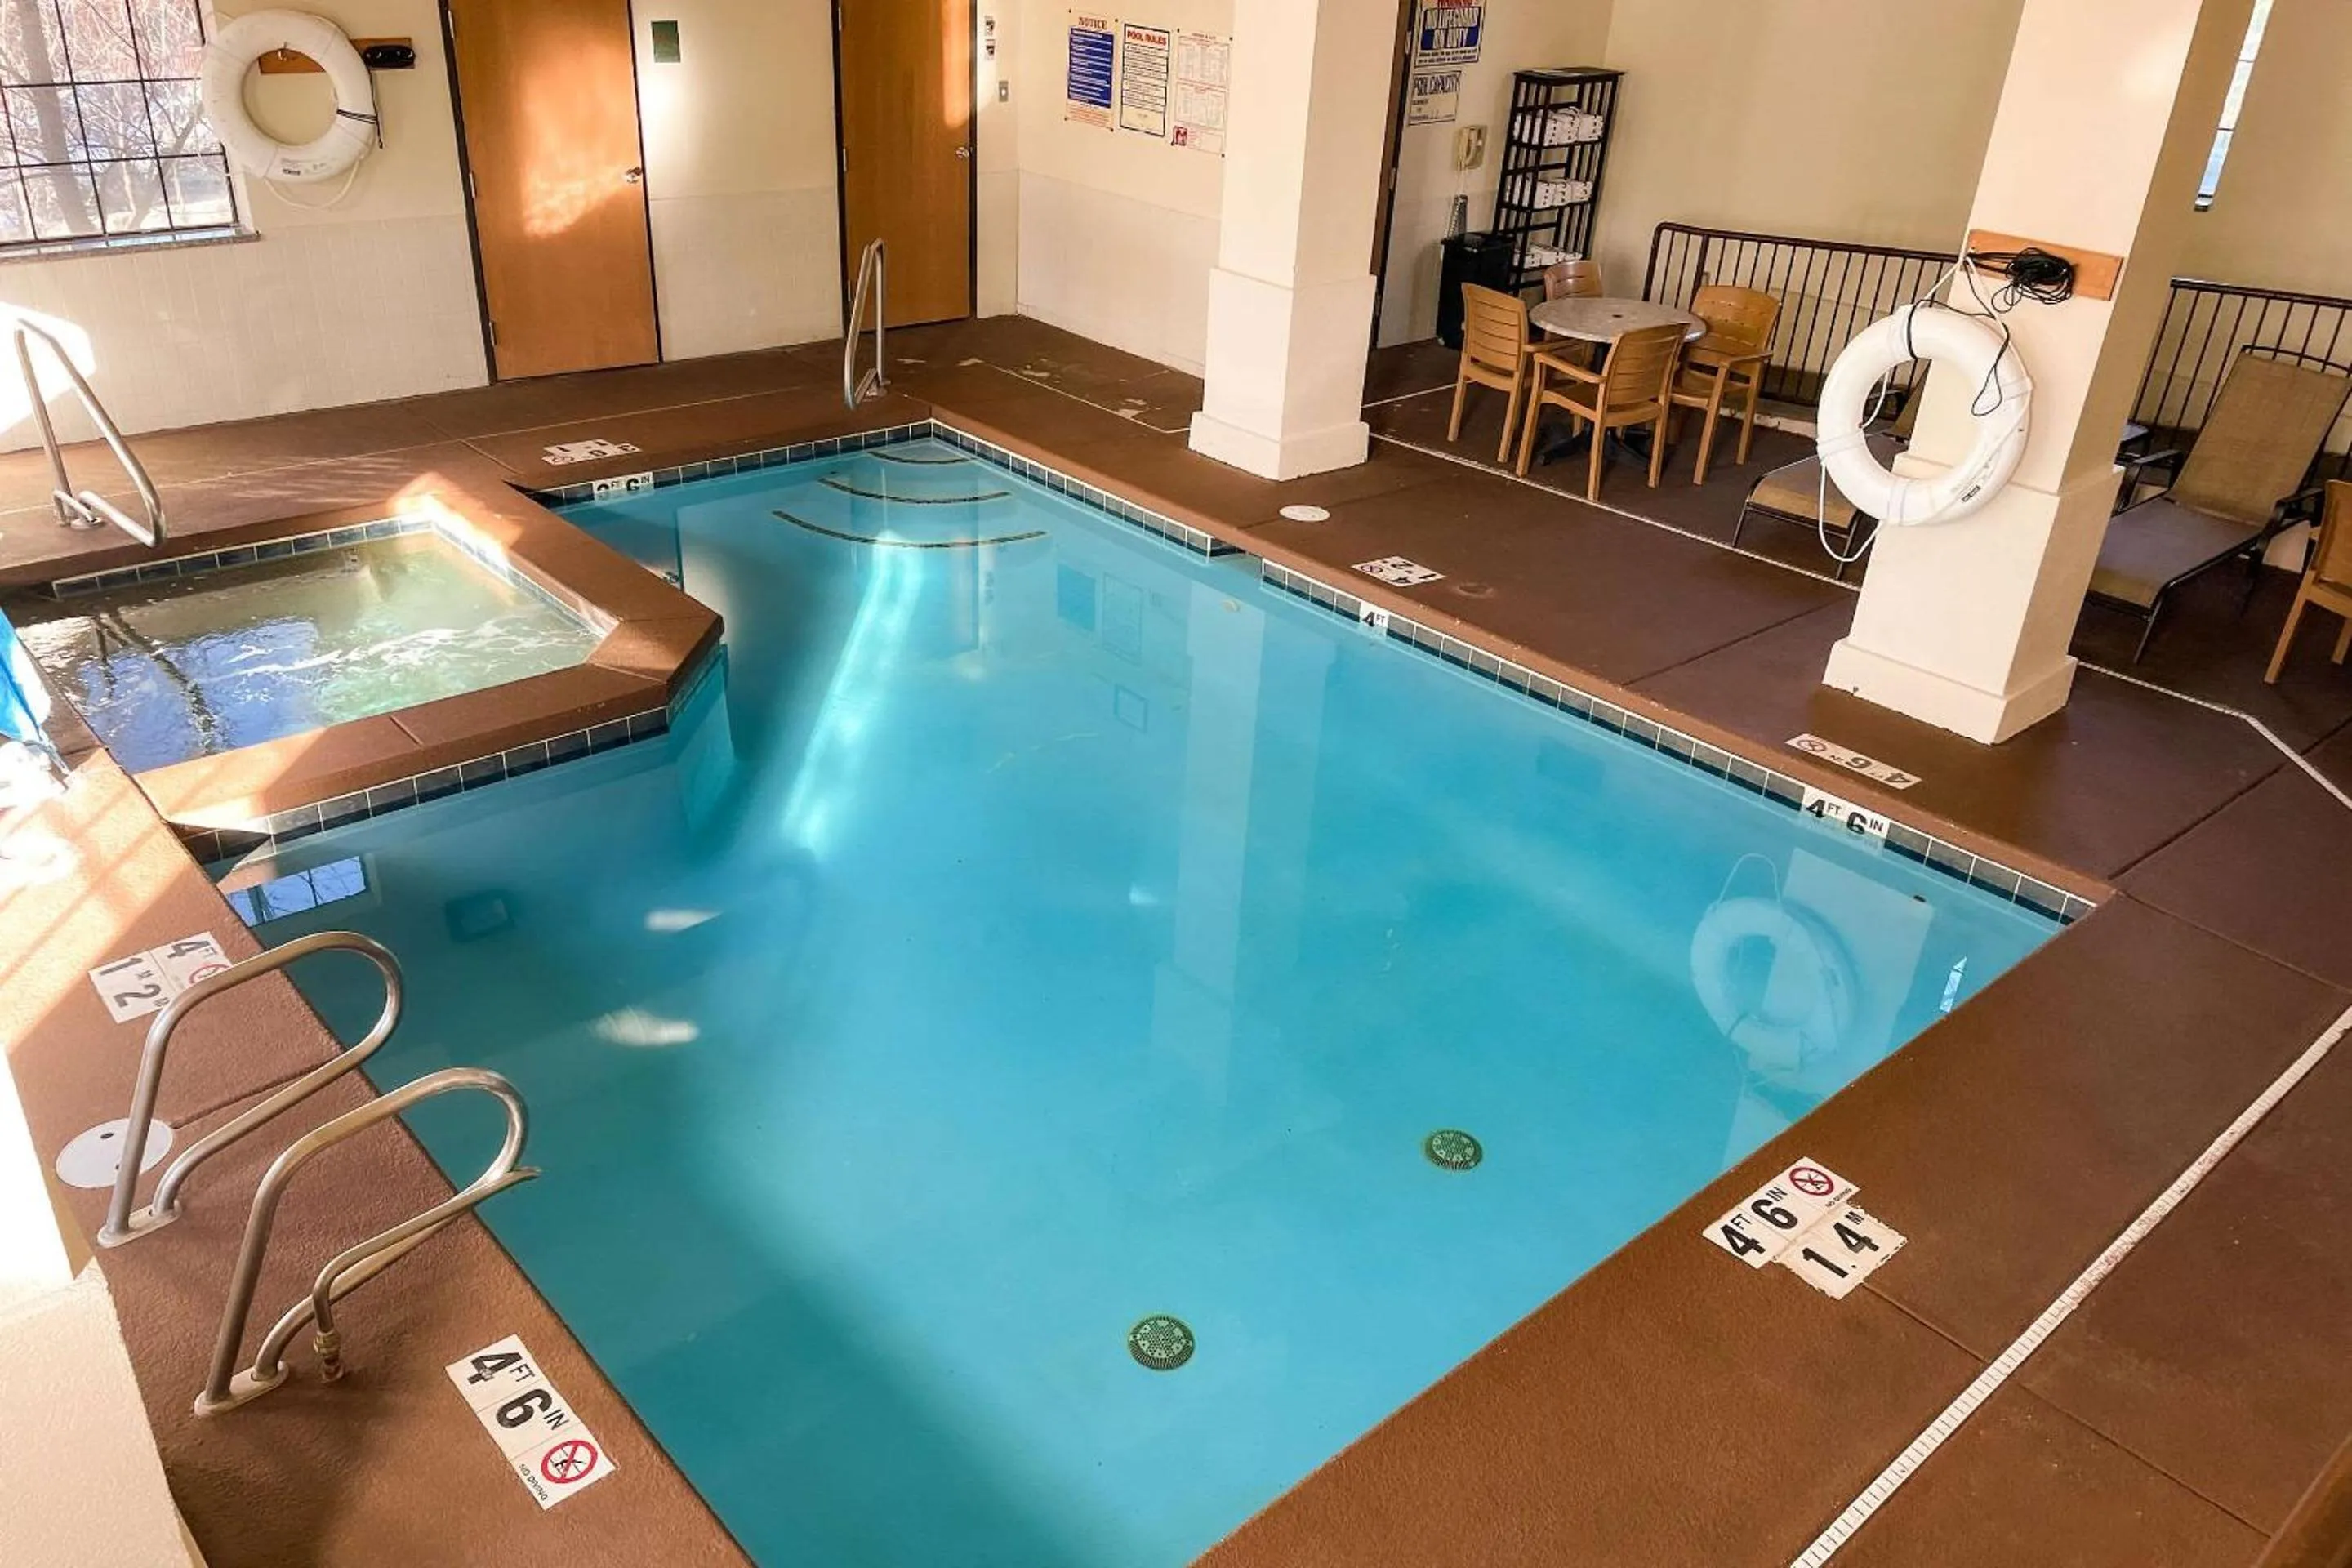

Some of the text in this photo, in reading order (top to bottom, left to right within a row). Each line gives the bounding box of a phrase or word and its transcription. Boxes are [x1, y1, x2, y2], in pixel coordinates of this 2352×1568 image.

[1145, 33, 1167, 46] RULES
[1806, 799, 1825, 818] 4
[1846, 811, 1868, 835] 6
[1869, 819, 1883, 832] IN
[167, 941, 211, 959] 4
[1720, 1186, 1798, 1257] 4 FT 6 IN
[467, 1352, 571, 1432] 4 FT 6 IN
